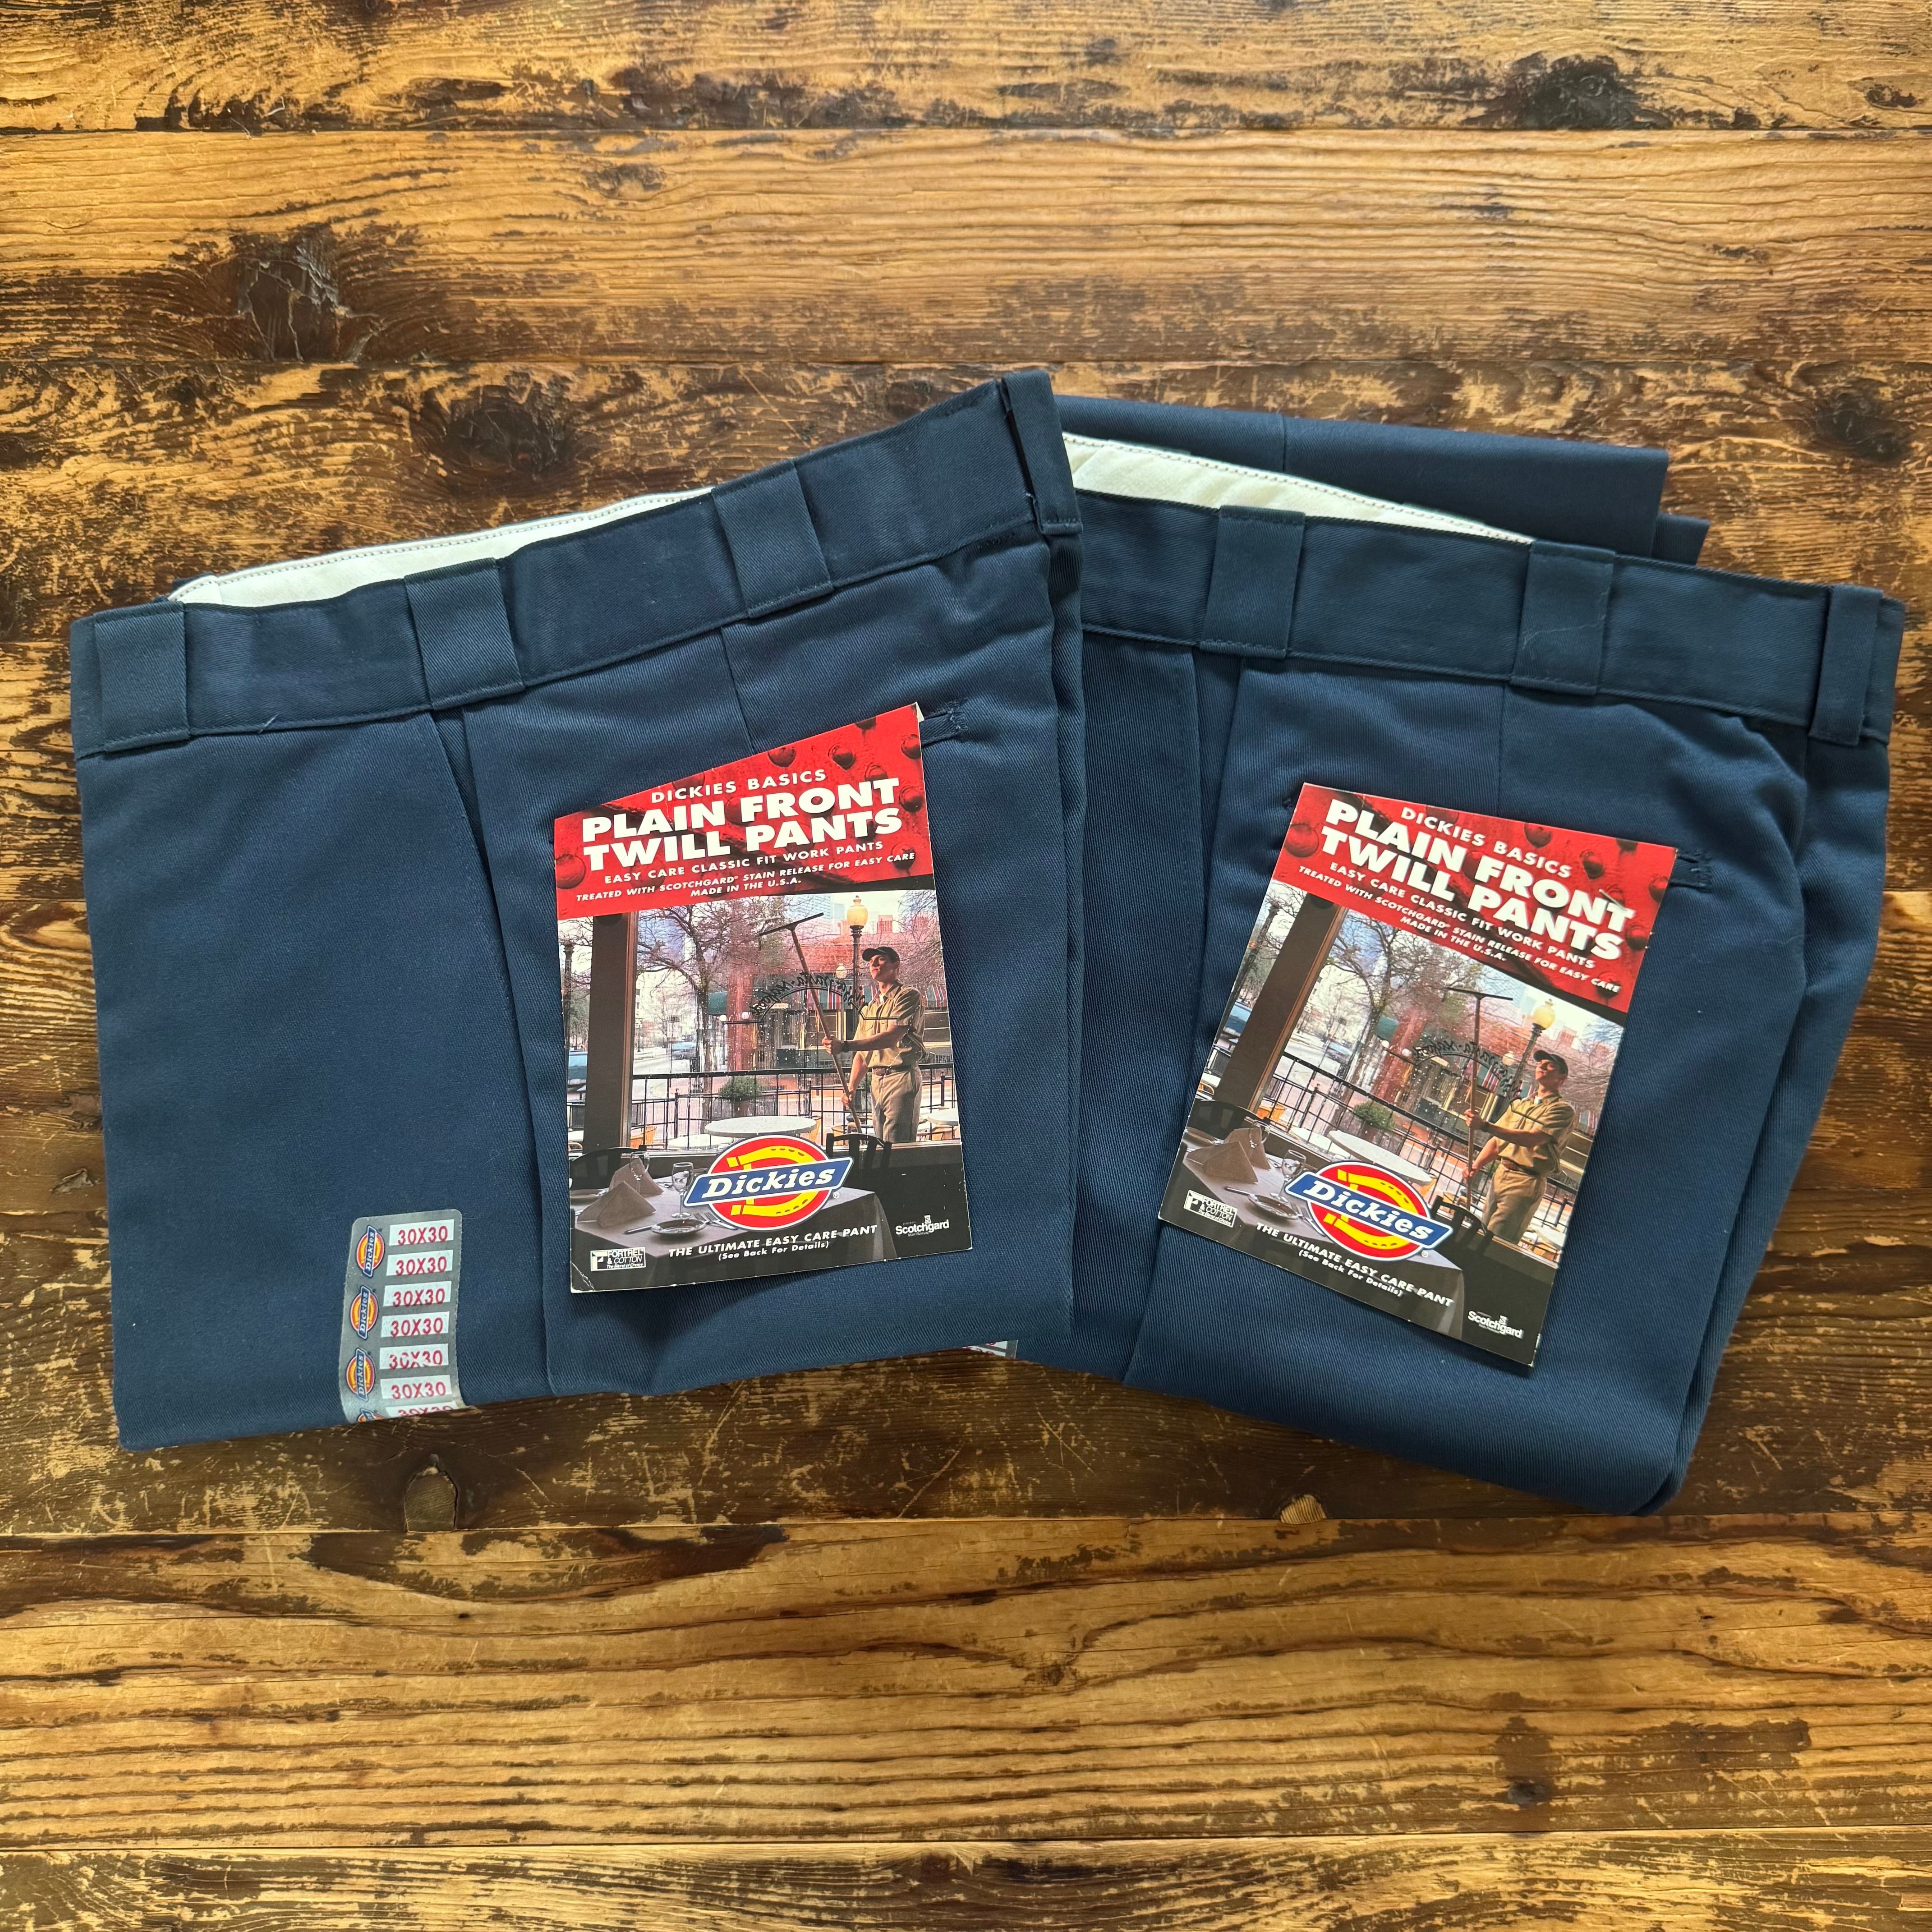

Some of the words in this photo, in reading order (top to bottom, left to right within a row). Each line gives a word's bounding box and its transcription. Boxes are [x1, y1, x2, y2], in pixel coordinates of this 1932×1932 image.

[651, 781, 737, 803] DICKIES
[747, 769, 826, 790] BASICS
[582, 800, 725, 842] PLAIN
[740, 777, 899, 823] FRONT
[583, 831, 731, 871] TWILL
[745, 808, 902, 852] PANTS
[1401, 807, 1486, 846] DICKIES
[1494, 841, 1573, 878] BASICS
[576, 890, 622, 902] TREATED
[626, 886, 655, 896] WITH
[743, 870, 775, 881] STAIN
[779, 865, 824, 877] RELEASE
[828, 861, 850, 870] FOR
[855, 857, 883, 867] EASY
[887, 852, 915, 862] CARE
[604, 872, 642, 884] EASY
[648, 866, 685, 879] CARE
[691, 859, 750, 873] CLASSIC
[757, 855, 777, 865] FIT
[782, 848, 829, 862] WORK
[836, 841, 883, 855] PANTS
[1325, 799, 1467, 873] PLAIN
[1474, 856, 1636, 932] FRONT
[690, 887, 722, 897] MADE
[744, 881, 764, 890] THE
[768, 877, 802, 888] U.S.A.
[1321, 826, 1455, 902] TWILL
[1467, 884, 1624, 960] PANTS
[1298, 865, 1342, 887] TREATED
[1345, 884, 1373, 900] WITH
[1453, 927, 1486, 943] STAIN
[1487, 940, 1533, 961] RELEASE
[1534, 957, 1558, 971] FOR
[1559, 966, 1591, 981] EASY
[1591, 978, 1621, 993] CARE
[1330, 862, 1366, 881] EASY
[1370, 879, 1406, 898] CARE
[1411, 895, 1467, 922] CLASSIC
[1472, 918, 1494, 931] FIT
[1498, 927, 1544, 950] WORK
[1547, 946, 1596, 969] PANTS
[1400, 916, 1432, 932] MADE
[1434, 929, 1448, 939] IN
[1450, 935, 1471, 948] THE
[1473, 944, 1507, 961] U.S.A.
[701, 1168, 836, 1198] Dickies
[895, 1219, 949, 1235] Scotchgard
[1206, 1206, 1233, 1221] COTTON
[1303, 1180, 1434, 1239] Dickies
[366, 1232, 374, 1271] Dickies
[398, 1226, 448, 1246] 30X30
[668, 1248, 693, 1258] THE
[698, 1239, 760, 1255] ULTIMATE
[766, 1235, 799, 1247] EASY
[804, 1229, 837, 1242] CARE
[842, 1224, 878, 1237] PANT
[718, 1252, 740, 1261] (See
[743, 1247, 768, 1257] Back
[772, 1246, 787, 1255] For
[791, 1240, 830, 1251] Details)
[396, 1256, 447, 1276] 30X30
[1256, 1222, 1279, 1237] THE
[1283, 1233, 1342, 1262] ULTIMATE
[1345, 1259, 1378, 1277] EASY
[1381, 1274, 1415, 1292] CARE
[1417, 1288, 1454, 1307] PANT
[1298, 1249, 1319, 1262] (See
[1322, 1259, 1344, 1273] Back
[1348, 1270, 1364, 1280] For
[1366, 1277, 1404, 1297] Details)
[393, 1288, 445, 1307] 30X30
[390, 1317, 443, 1337] 30X30
[1468, 1311, 1523, 1339] Scotchgard
[389, 1350, 443, 1370] 30X30
[391, 1382, 446, 1399] 30X30
